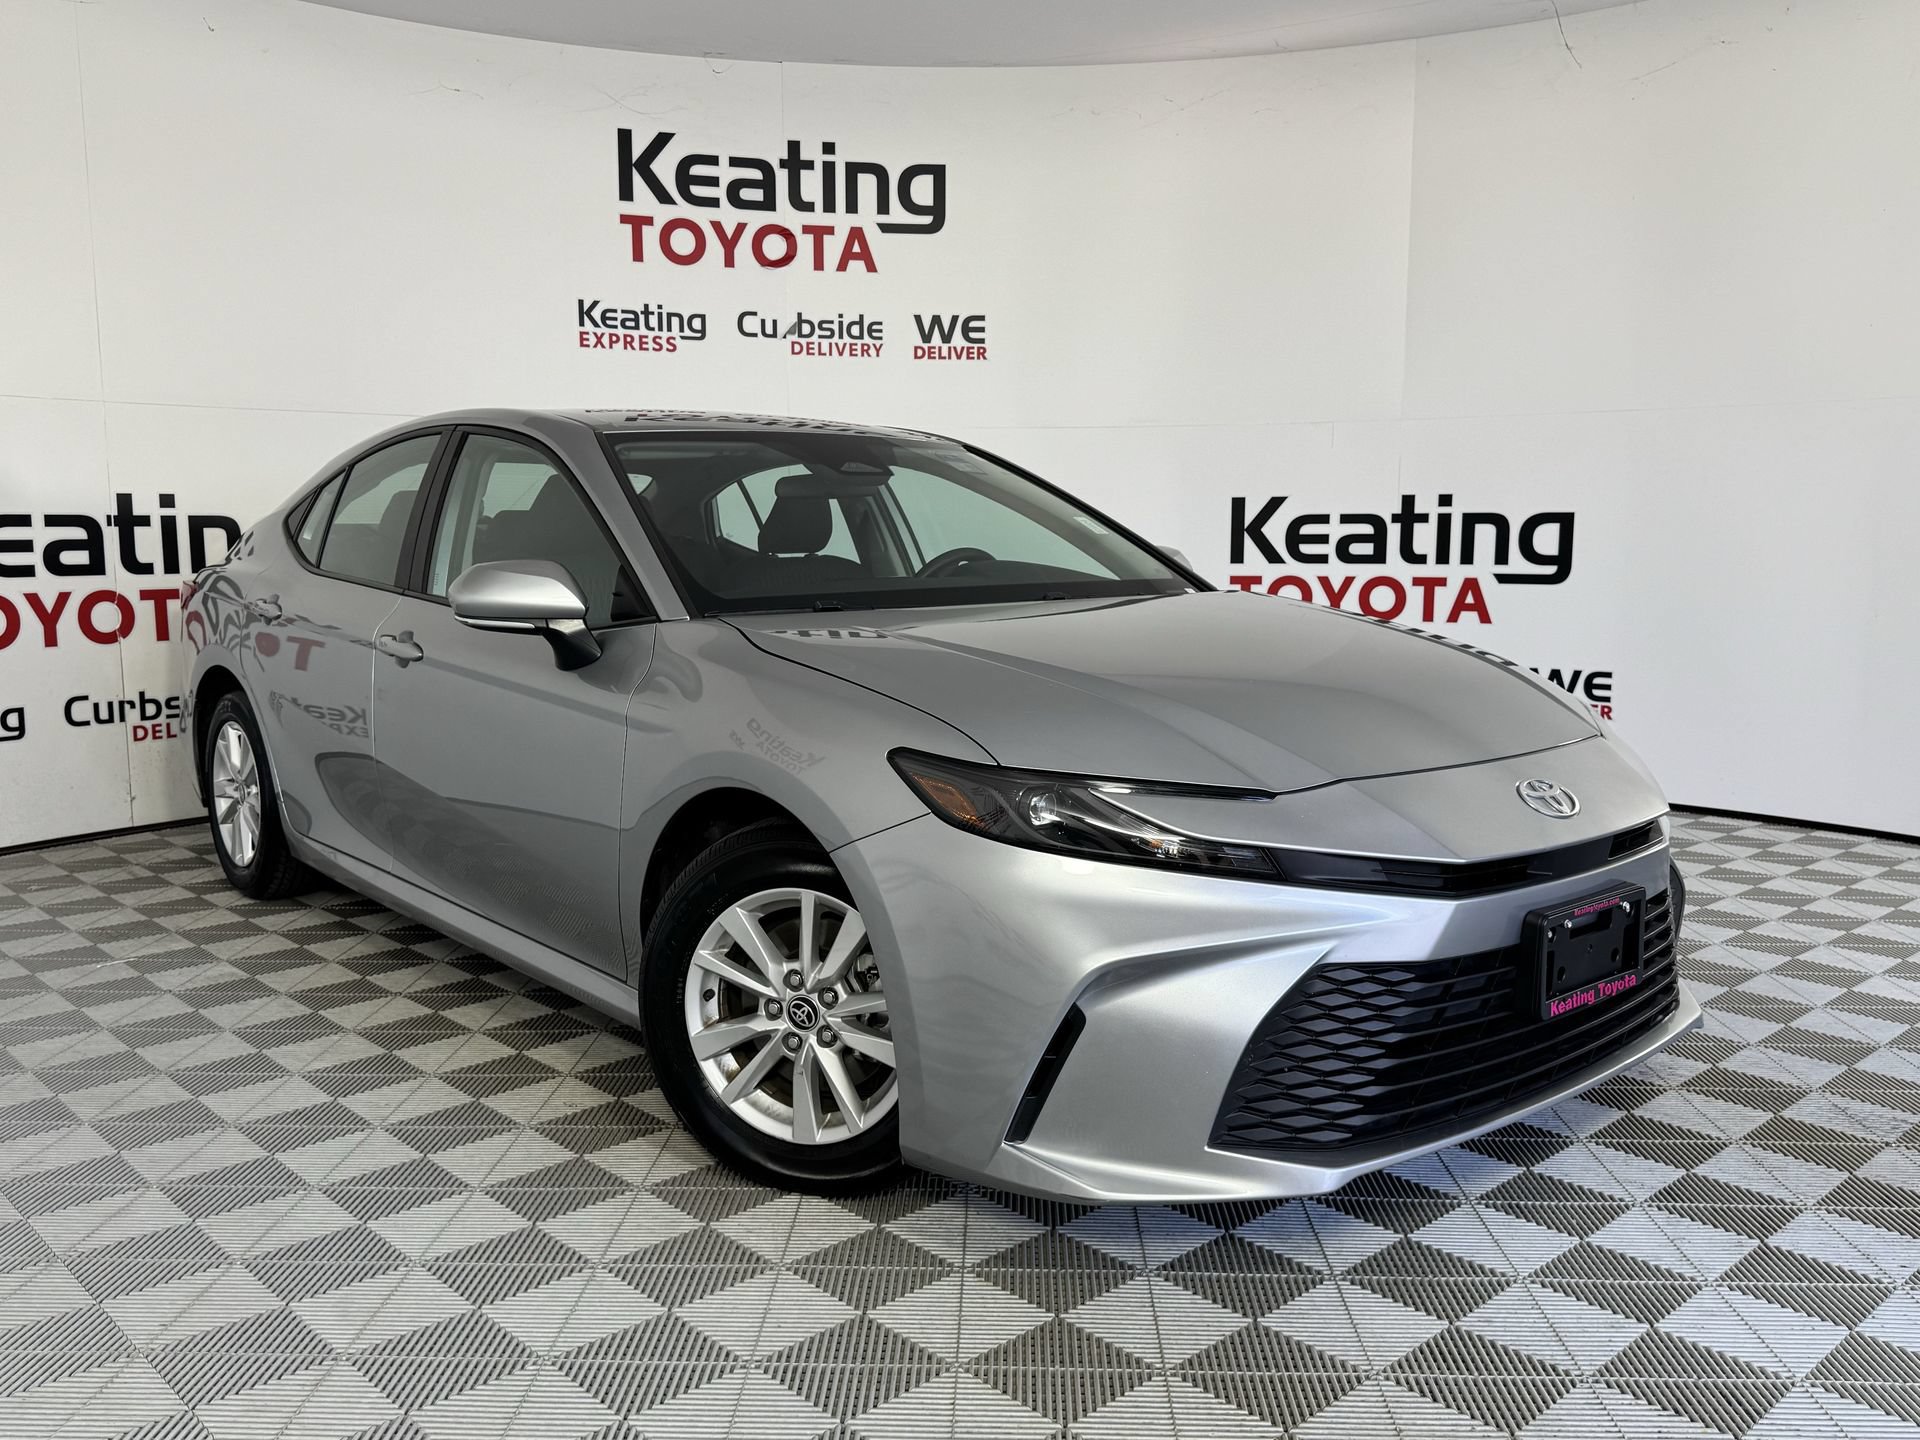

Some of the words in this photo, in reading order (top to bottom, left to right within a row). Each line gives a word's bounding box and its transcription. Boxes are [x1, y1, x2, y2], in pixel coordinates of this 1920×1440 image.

[617, 128, 946, 234] Keating
[619, 214, 878, 273] TOYOTA
[578, 299, 706, 340] Keating
[737, 311, 883, 340] Cubside
[913, 314, 986, 344] WE
[579, 331, 677, 352] EXPRESS
[791, 341, 883, 357] DELIVERY
[914, 346, 987, 360] DELIVER
[1230, 494, 1575, 585] Keating
[1550, 989, 1595, 1017] Keating
[1598, 974, 1637, 997] Toyota
